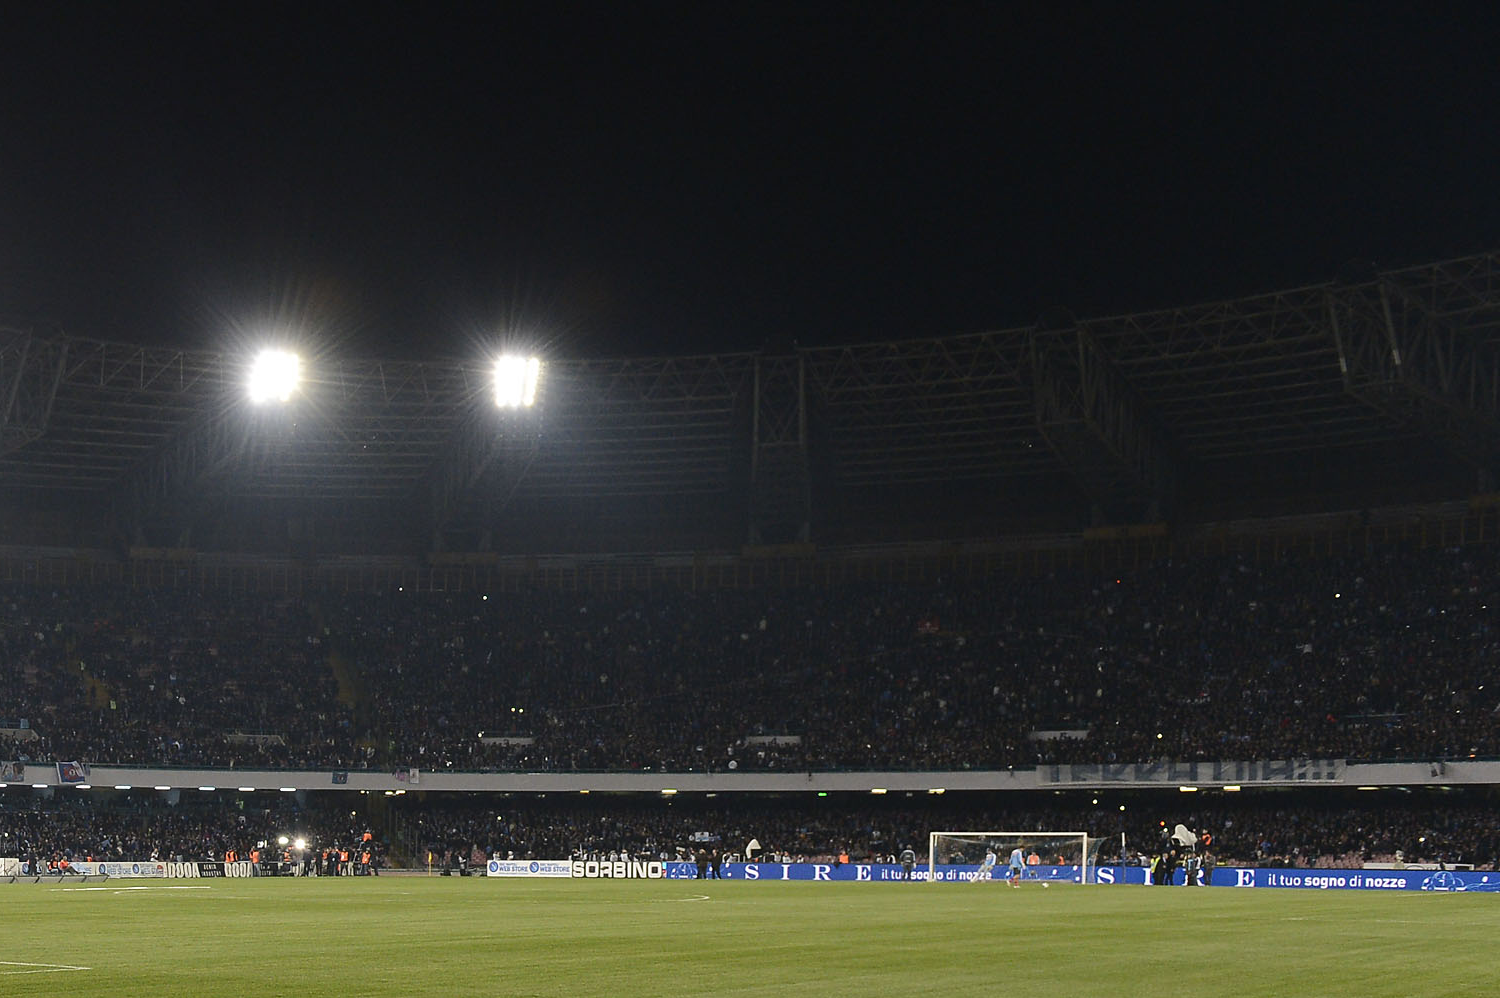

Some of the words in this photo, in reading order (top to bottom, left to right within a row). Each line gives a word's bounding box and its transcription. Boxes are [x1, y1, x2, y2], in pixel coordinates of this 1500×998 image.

[573, 861, 662, 878] SORBINO
[881, 869, 889, 880] il
[946, 870, 957, 880] di
[1268, 873, 1276, 886] il
[1280, 875, 1301, 886] tuo
[1304, 877, 1346, 889] sogno
[1349, 875, 1362, 887] di
[1365, 878, 1407, 889] nozze
